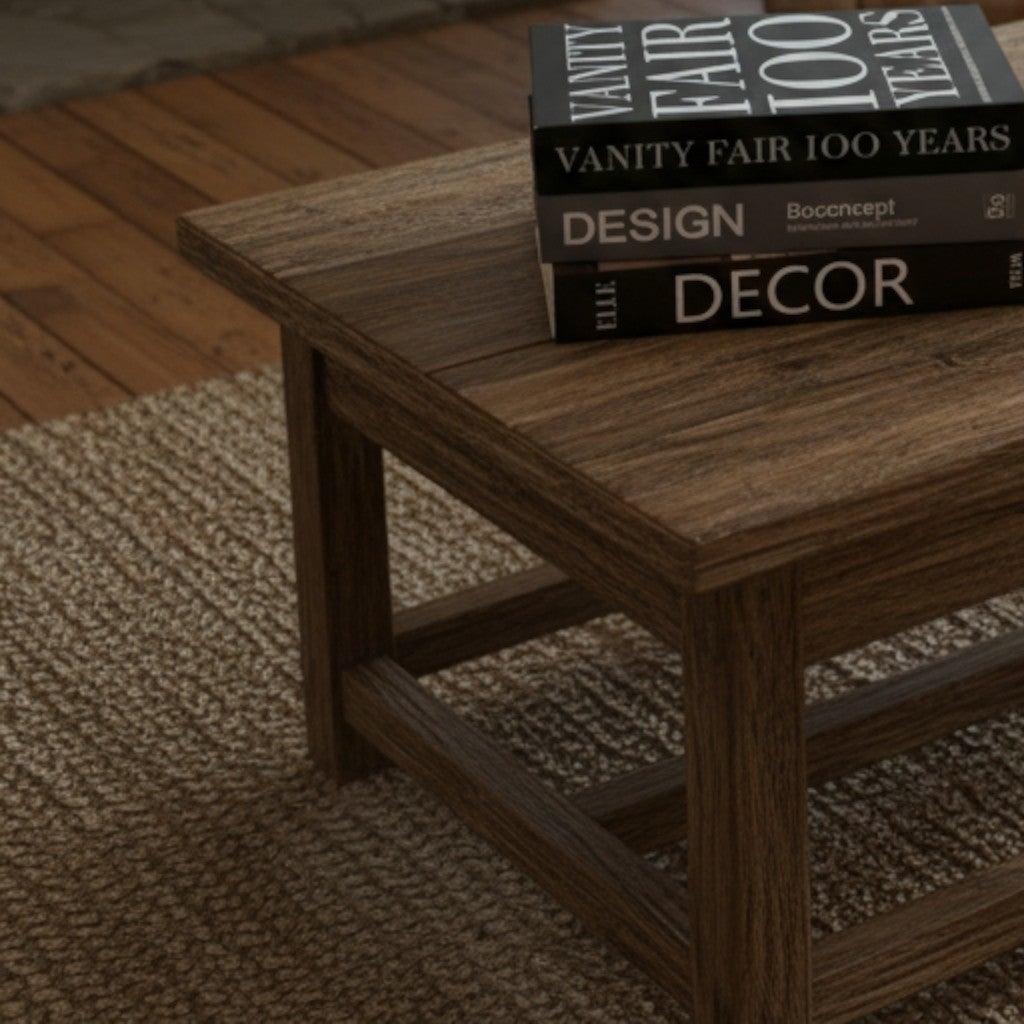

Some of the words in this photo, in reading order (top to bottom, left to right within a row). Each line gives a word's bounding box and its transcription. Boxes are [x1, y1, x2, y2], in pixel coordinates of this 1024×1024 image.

[564, 23, 634, 123] VANITY
[641, 17, 753, 119] FAIR
[859, 9, 961, 108] YEARS
[556, 139, 694, 174] VANITY
[707, 134, 792, 166] FAIR
[892, 123, 1012, 157] YEARS
[562, 202, 745, 247] DESIGN
[674, 257, 915, 325] DECOR
